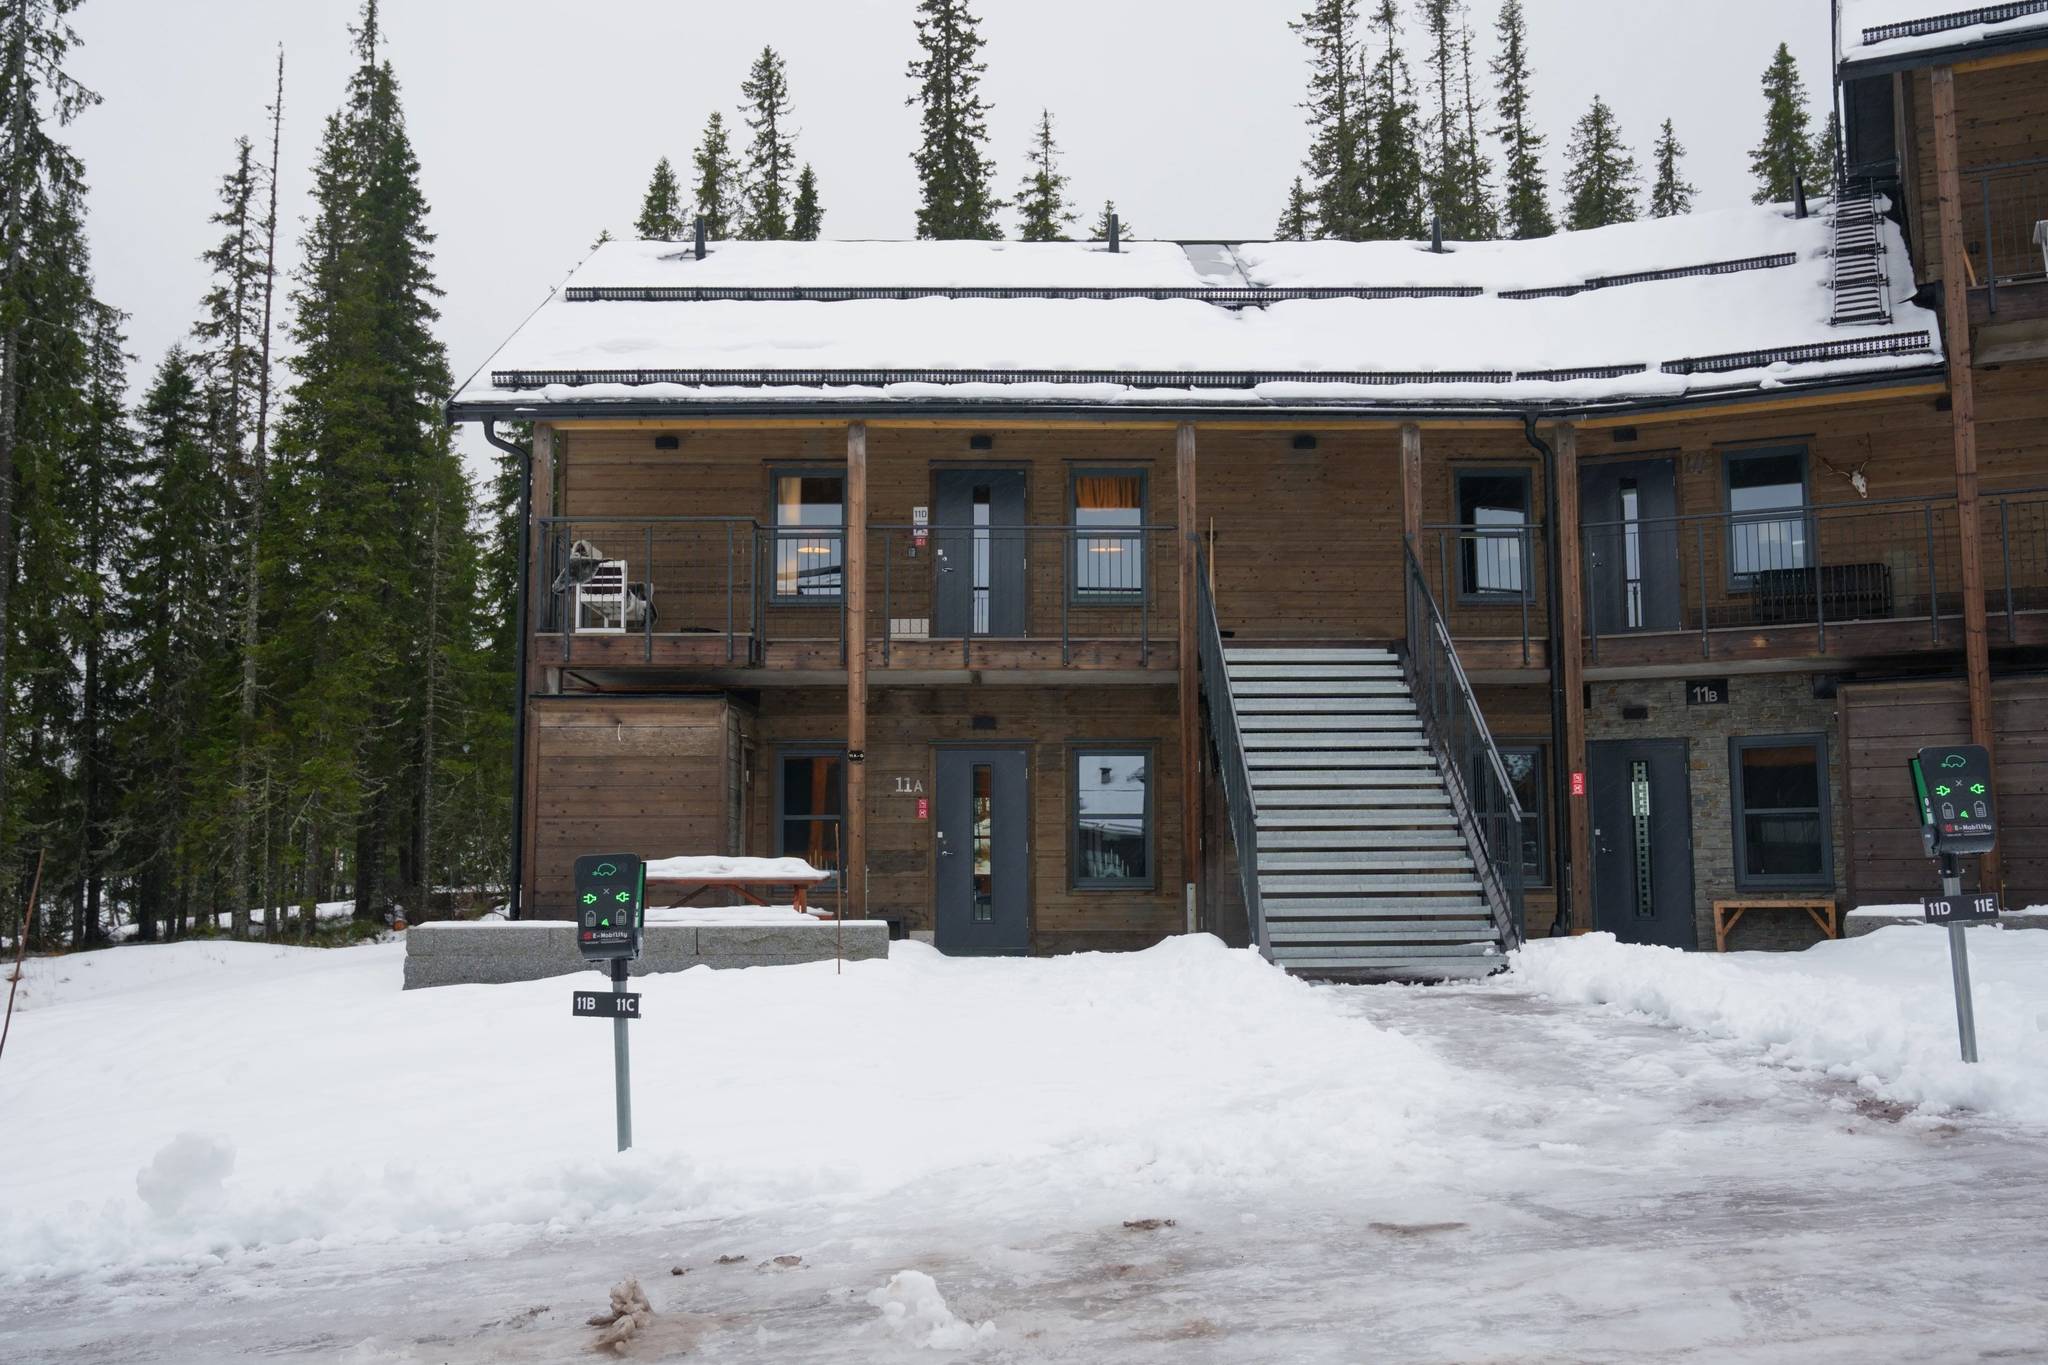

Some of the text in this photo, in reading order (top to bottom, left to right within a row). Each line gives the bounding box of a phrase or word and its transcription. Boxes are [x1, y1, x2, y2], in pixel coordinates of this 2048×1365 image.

[1692, 685, 1718, 703] 11B
[895, 776, 923, 793] 11A
[1954, 823, 1992, 831] E-Mobility
[1928, 898, 1994, 916] 11D 11E
[592, 931, 628, 939] E-Mobility
[576, 996, 635, 1012] 11B 11C
